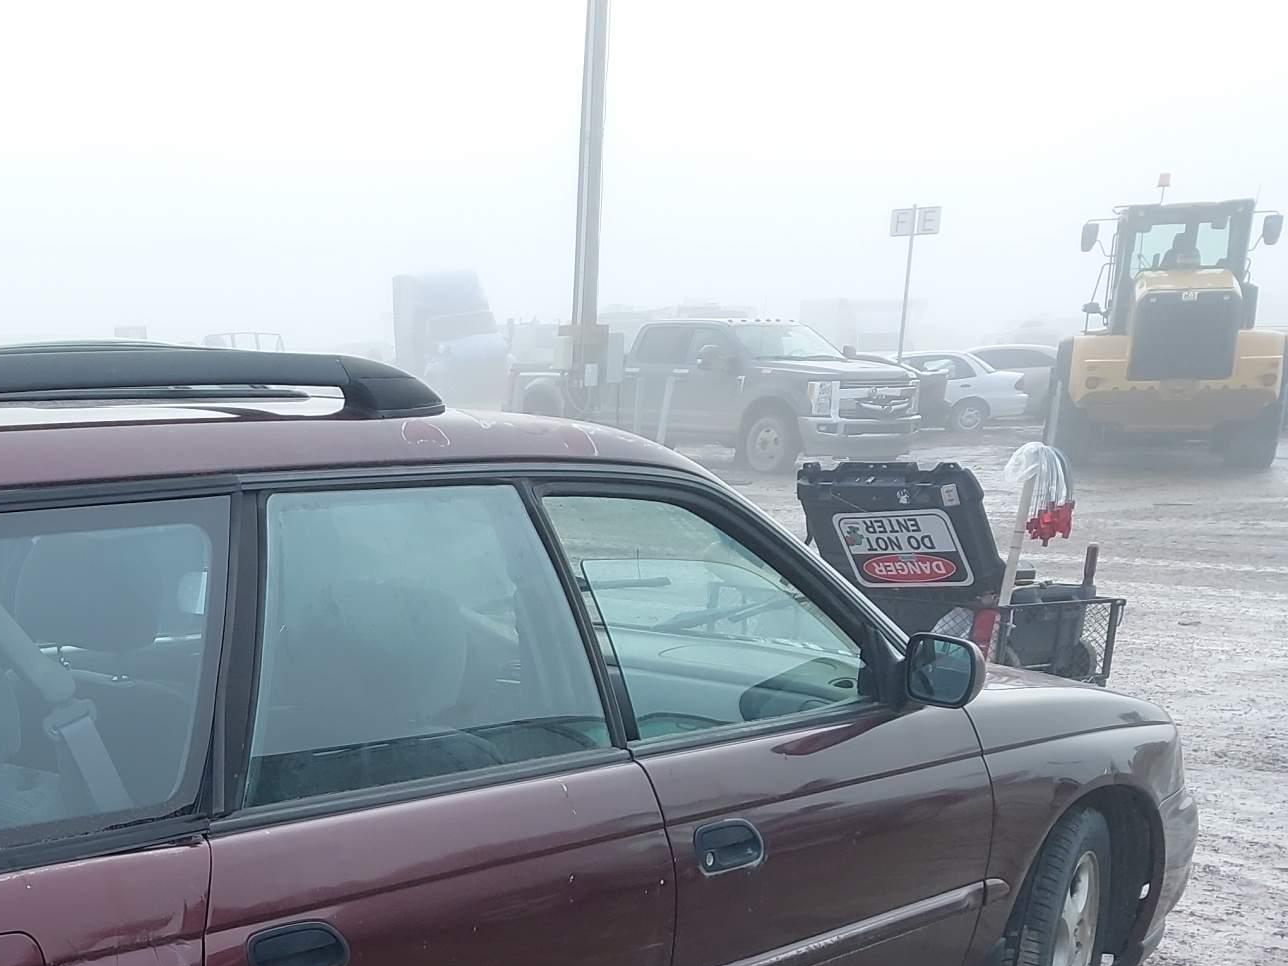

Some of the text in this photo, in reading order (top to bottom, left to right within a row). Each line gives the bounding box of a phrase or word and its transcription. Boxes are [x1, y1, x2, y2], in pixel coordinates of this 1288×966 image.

[921, 209, 937, 231] E
[1182, 290, 1200, 302] CAT
[863, 518, 922, 534] ENTER
[866, 534, 936, 552] DO NOT
[872, 560, 947, 576] DANGER
